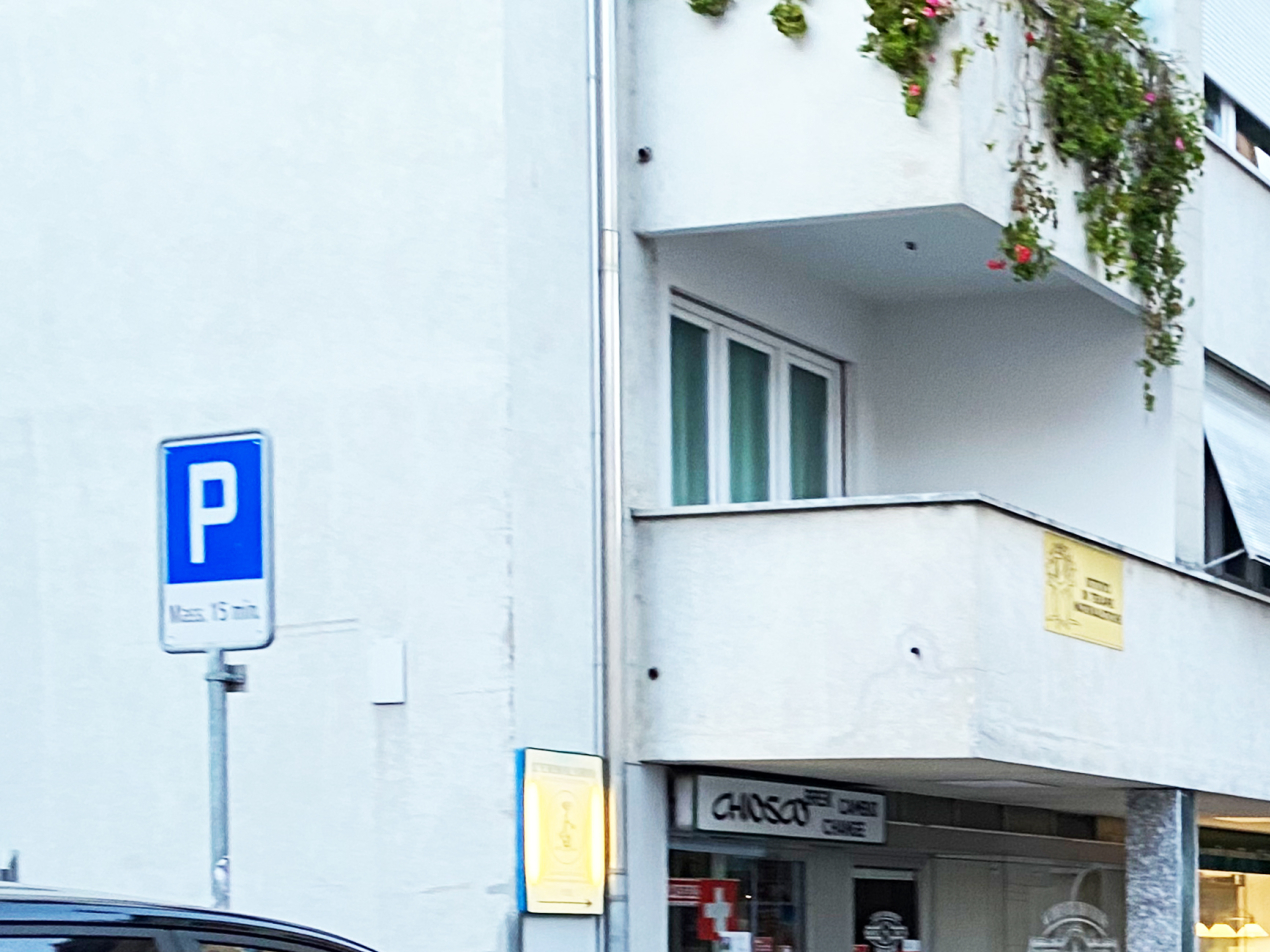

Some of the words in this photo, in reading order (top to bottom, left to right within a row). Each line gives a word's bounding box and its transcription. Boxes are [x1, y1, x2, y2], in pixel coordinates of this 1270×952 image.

[188, 460, 238, 564] P
[712, 791, 811, 827] CHIOSCO
[838, 798, 878, 818] CAMBIO
[822, 818, 867, 838] CHANGE
